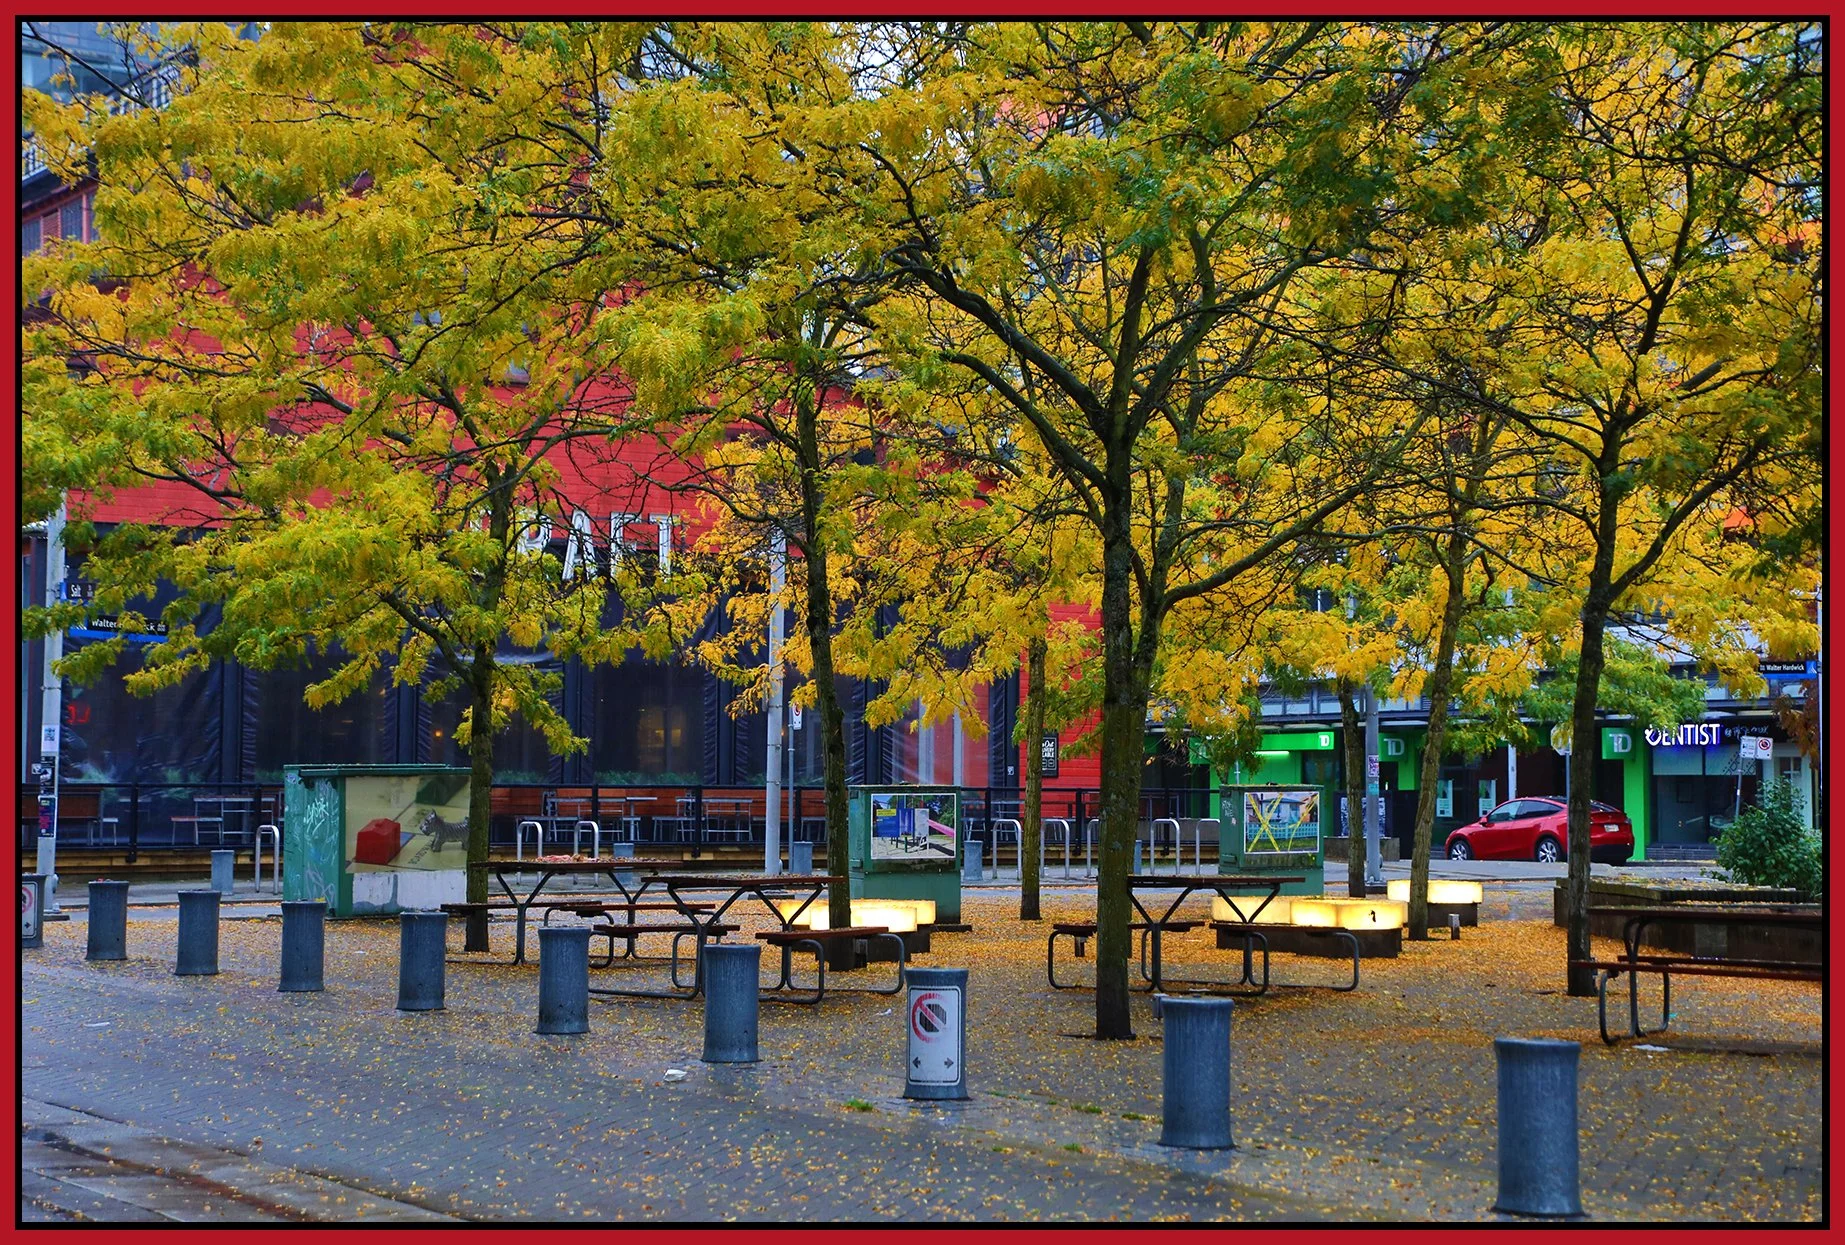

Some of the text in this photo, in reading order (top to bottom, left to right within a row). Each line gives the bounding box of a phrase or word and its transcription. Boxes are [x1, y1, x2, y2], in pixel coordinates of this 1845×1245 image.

[1318, 734, 1330, 747] TD
[1383, 738, 1405, 756] TD
[1608, 733, 1632, 753] TD
